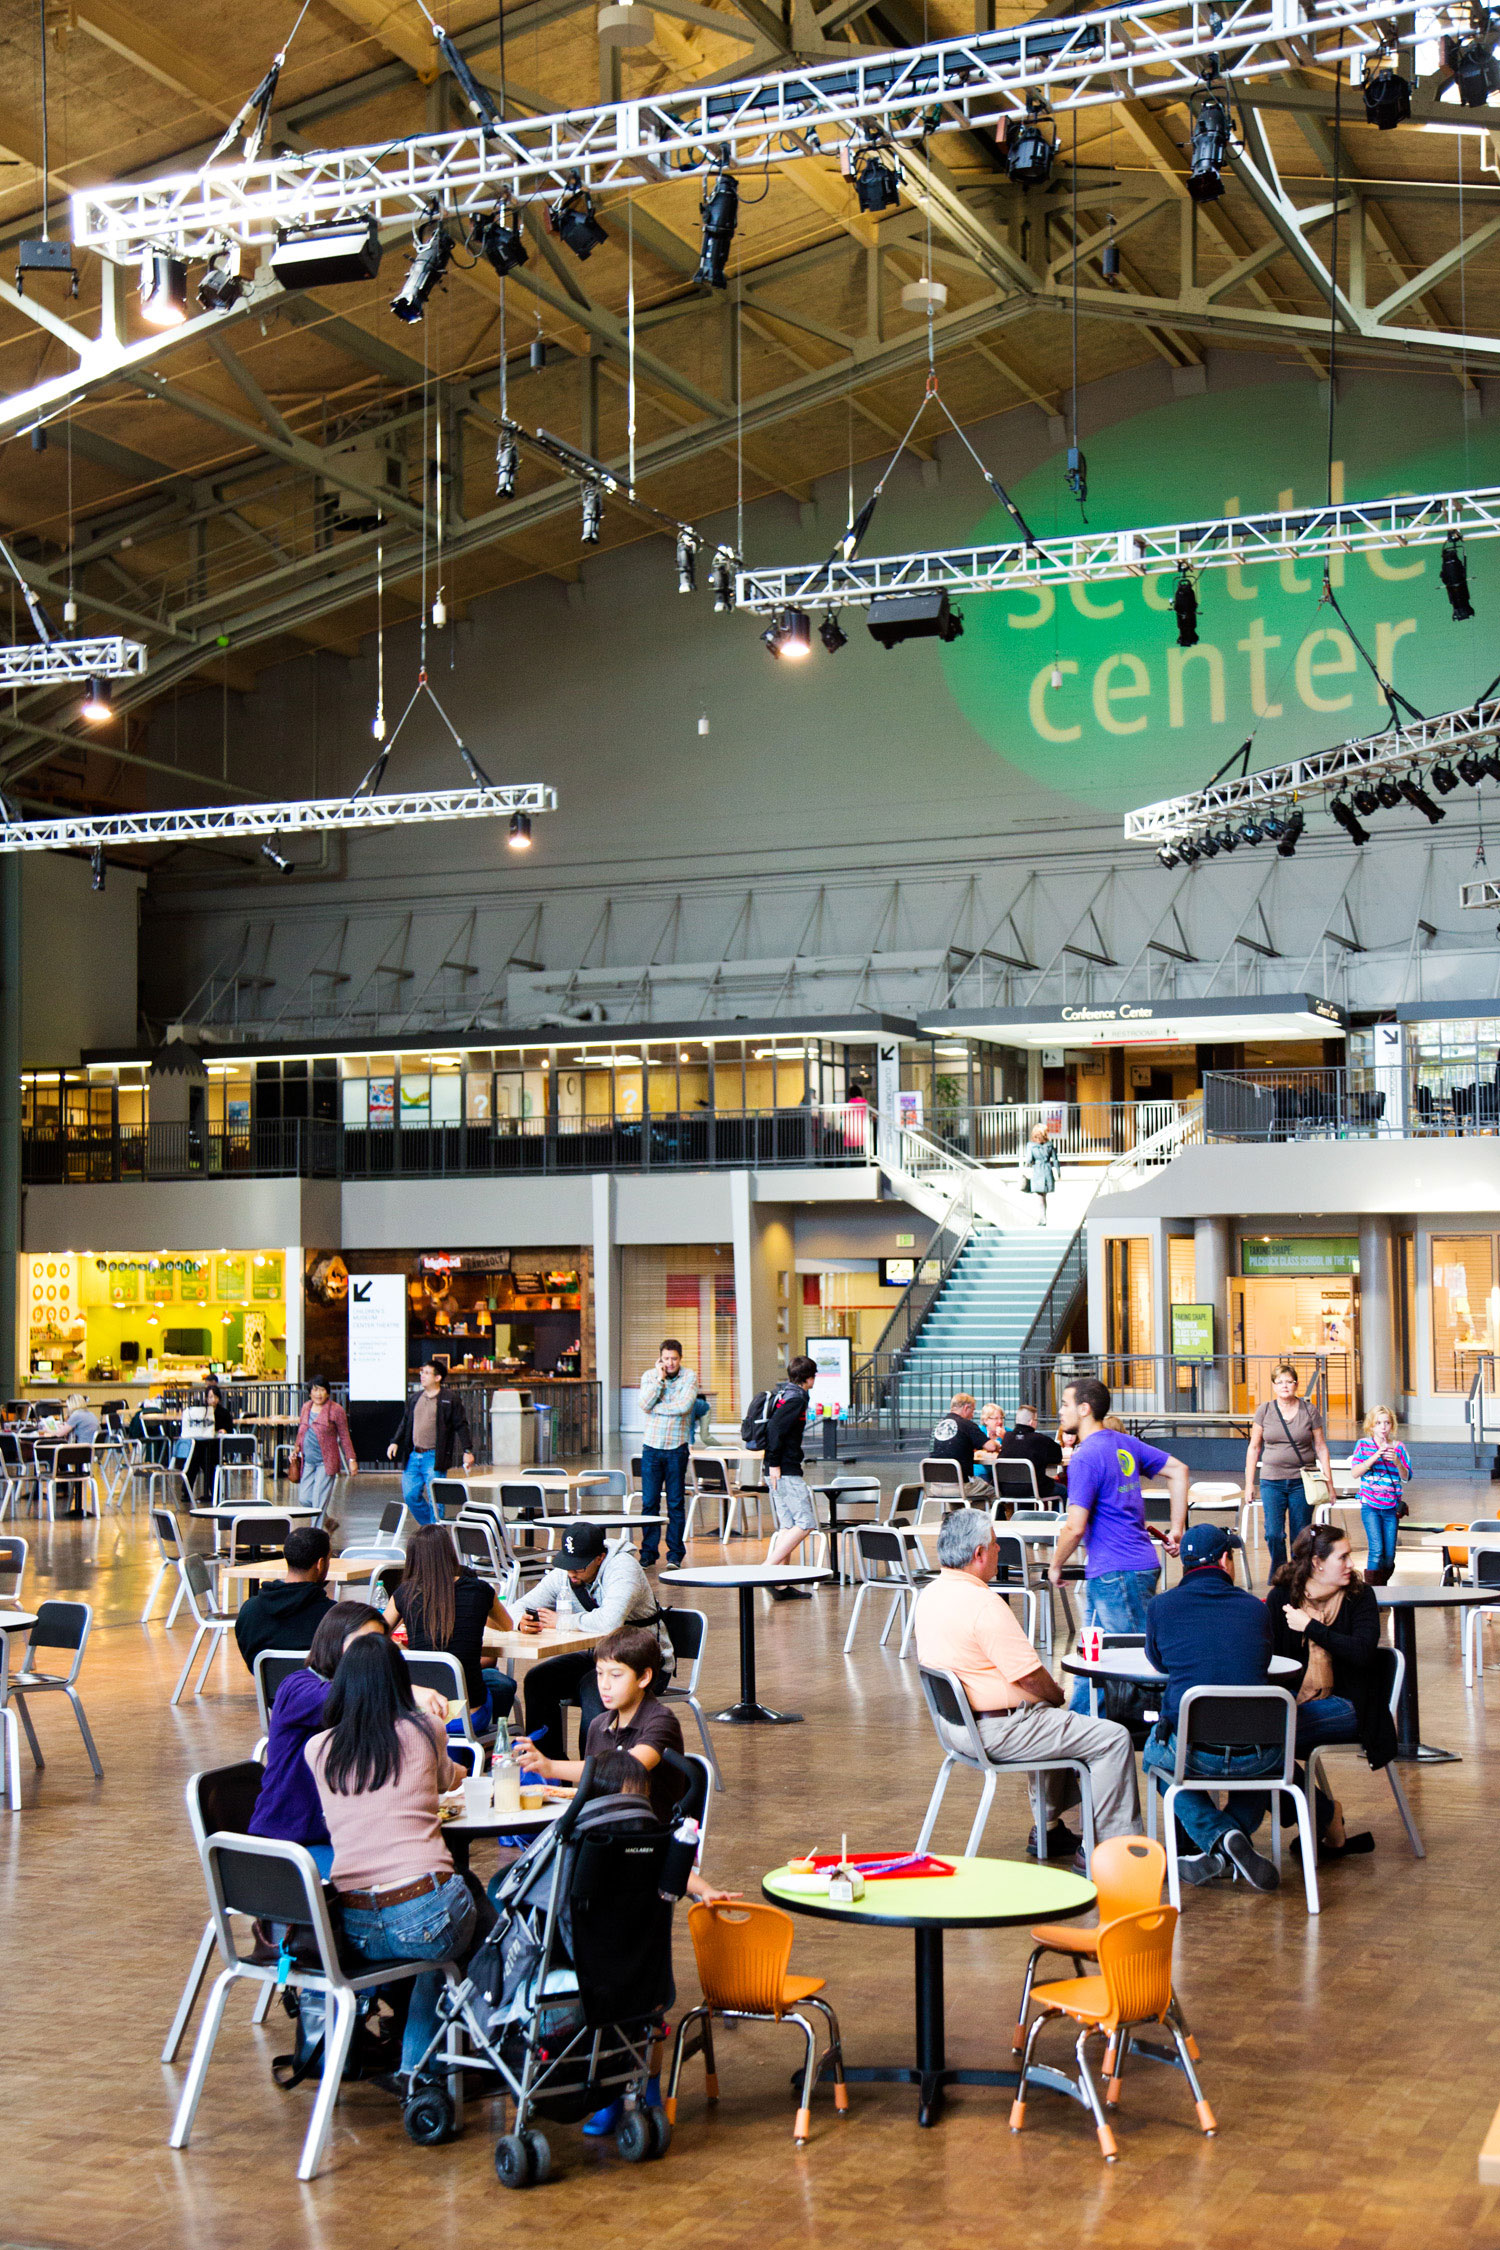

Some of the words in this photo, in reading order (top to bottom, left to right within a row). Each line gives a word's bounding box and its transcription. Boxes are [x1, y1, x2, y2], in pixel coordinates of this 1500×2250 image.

[1028, 616, 1418, 743] center
[1061, 1007, 1116, 1021] Conference
[1119, 1004, 1153, 1019] Center
[1111, 1030, 1158, 1038] RESTROOMS
[885, 1067, 893, 1111] CUSTOMER
[1249, 1245, 1269, 1256] TAKING
[1279, 1255, 1299, 1267] GLASS
[1299, 1255, 1323, 1267] SCHOOL
[1325, 1255, 1332, 1266] IN
[1333, 1255, 1345, 1266] THE
